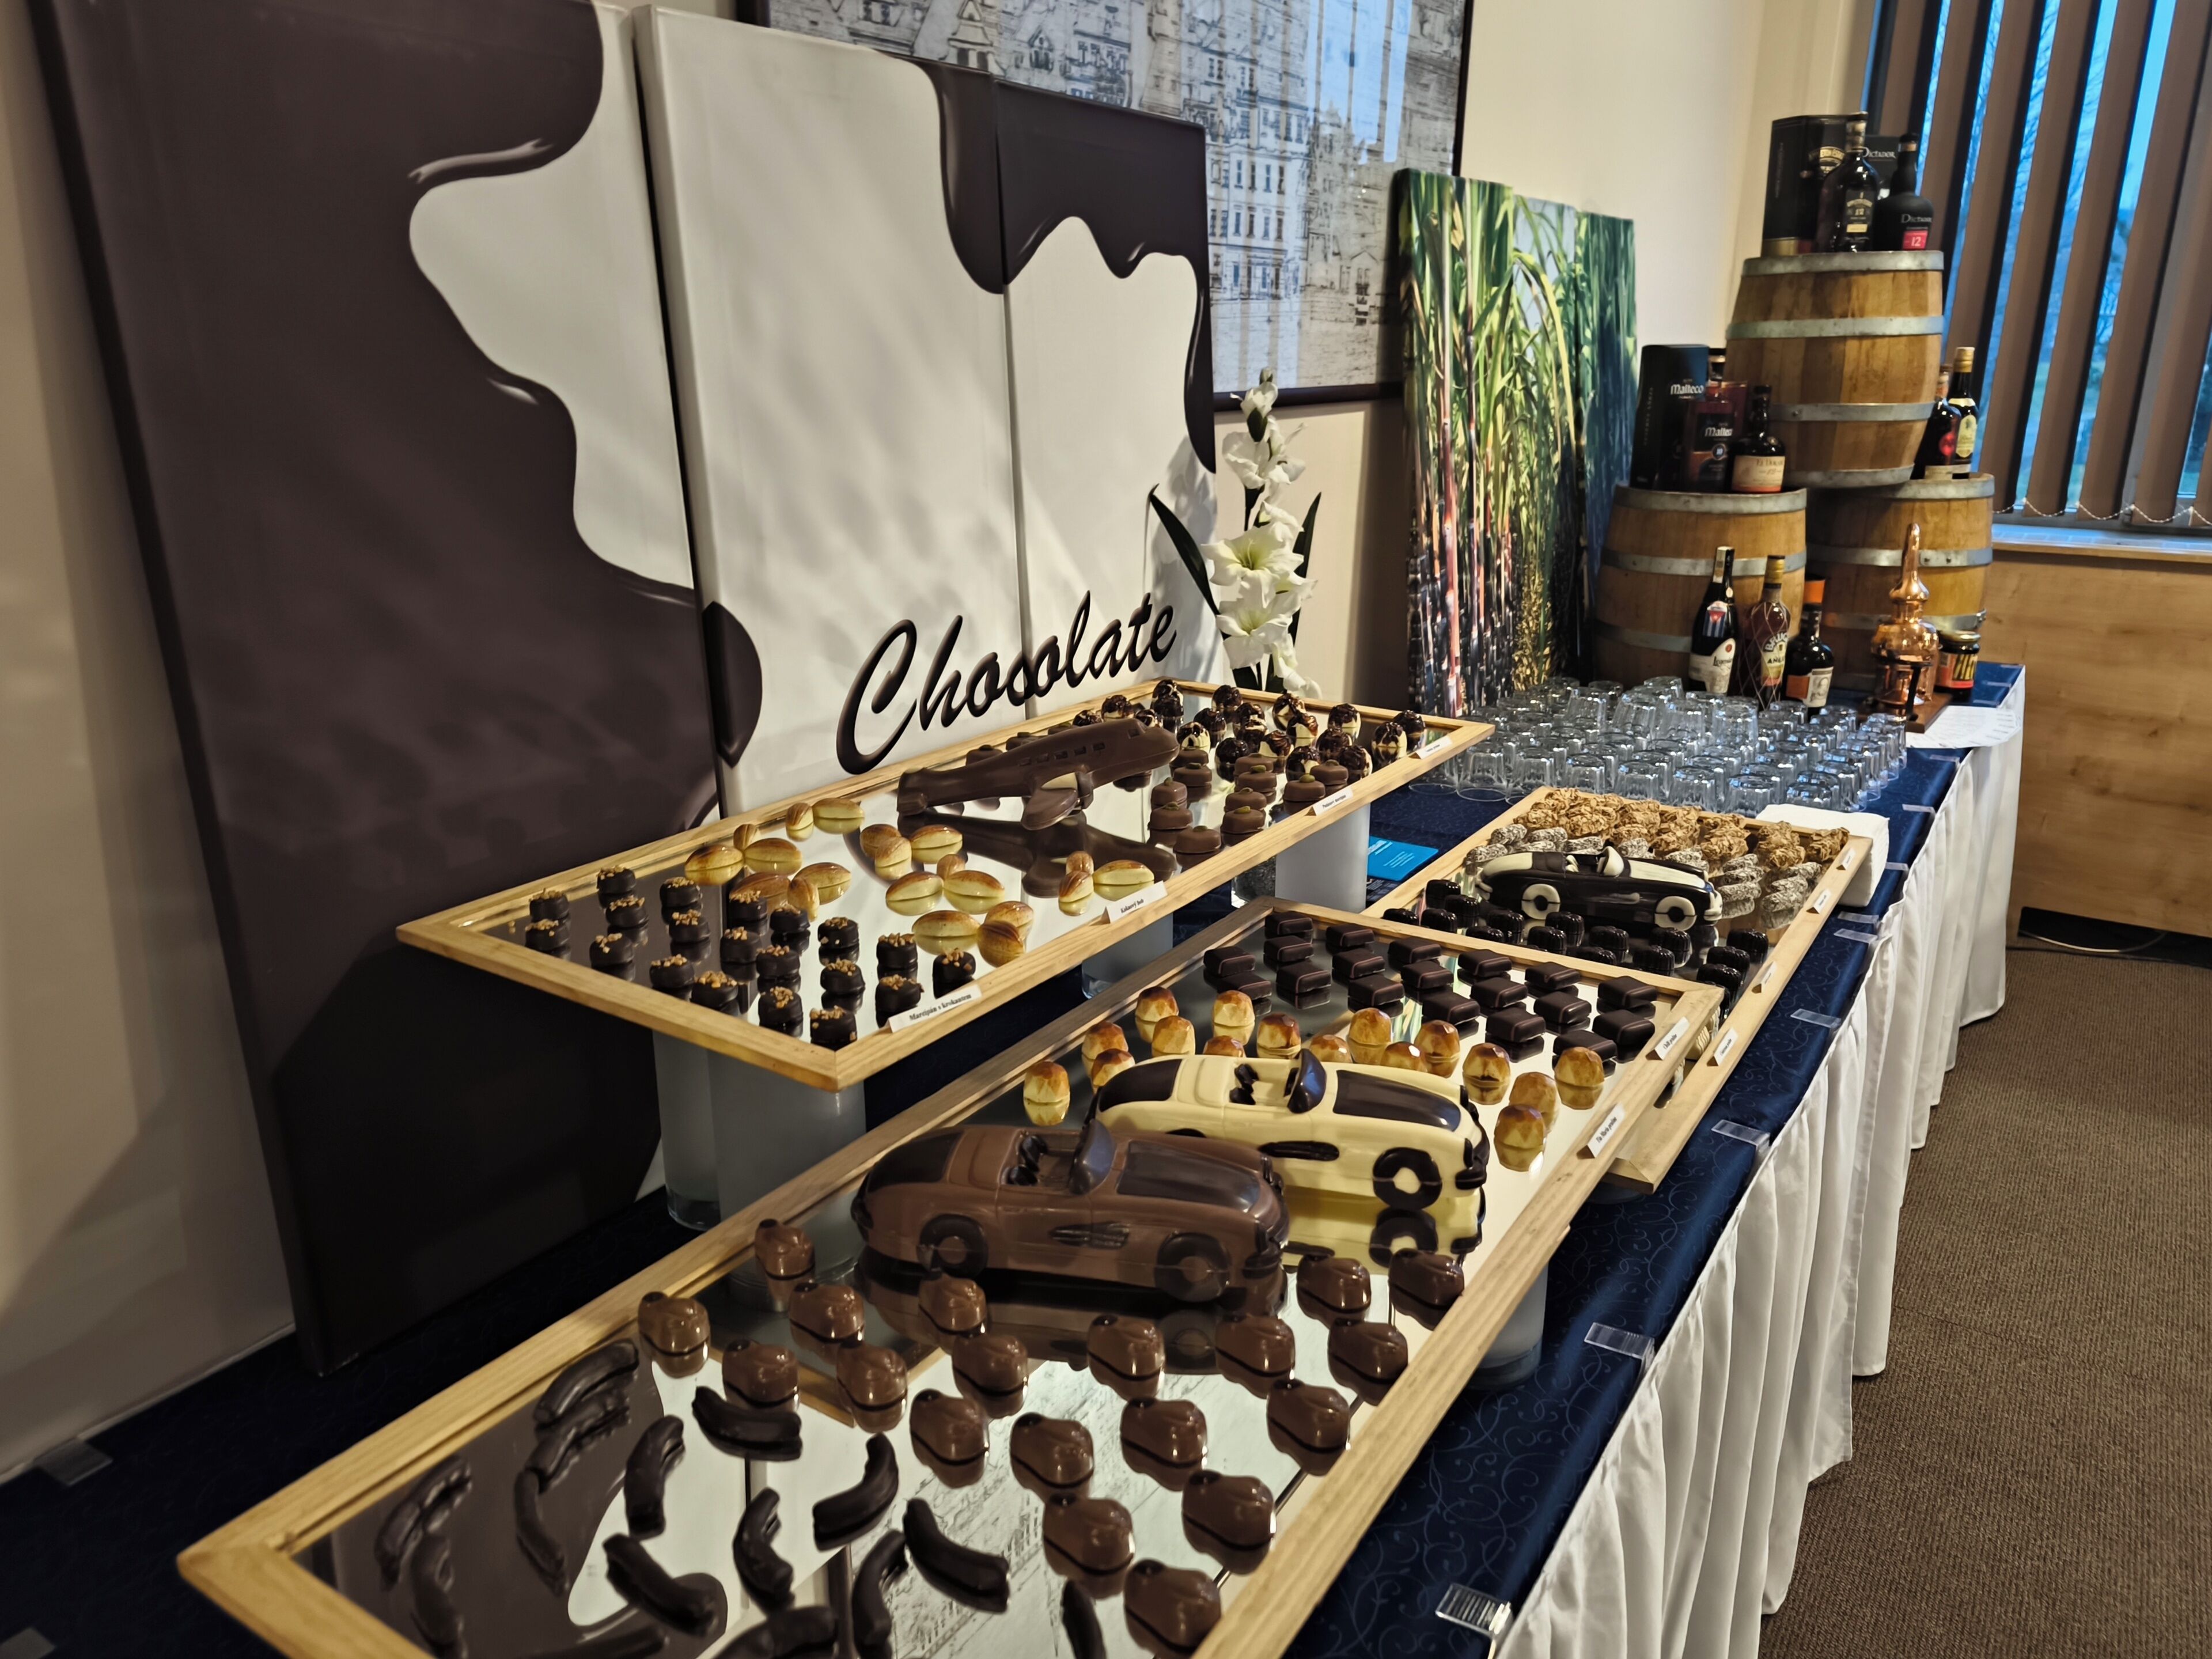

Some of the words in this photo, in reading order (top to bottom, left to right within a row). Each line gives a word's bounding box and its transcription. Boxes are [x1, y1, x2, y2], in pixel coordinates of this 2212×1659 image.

[1911, 236, 1922, 247] 12
[836, 589, 1177, 775] Chocolate
[909, 1006, 938, 1021] Marcipán
